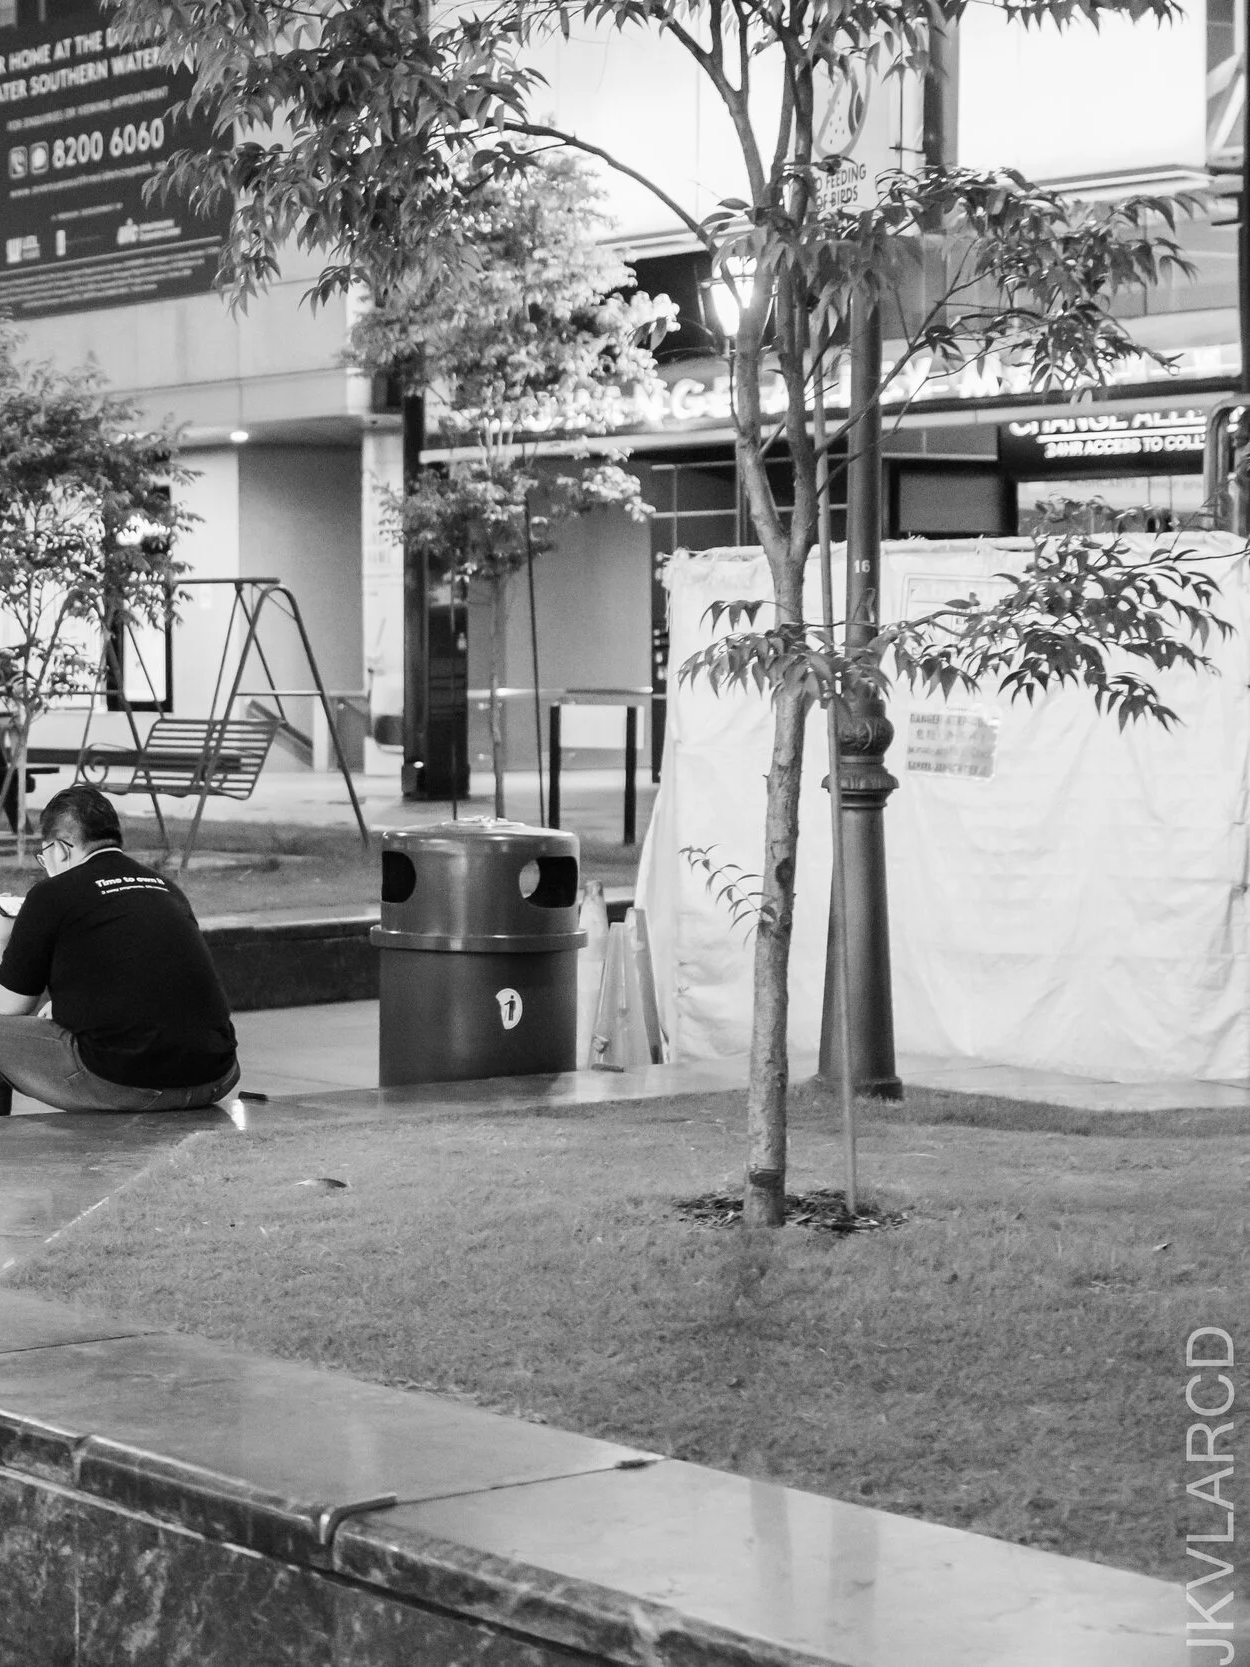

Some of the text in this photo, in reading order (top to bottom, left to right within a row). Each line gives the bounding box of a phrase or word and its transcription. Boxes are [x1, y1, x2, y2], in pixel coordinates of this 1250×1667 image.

[9, 44, 51, 71] HOME
[53, 38, 72, 61] AT
[74, 30, 104, 55] THE
[30, 59, 108, 96] SOUTHERN
[52, 117, 165, 170] 8200 6060
[826, 163, 867, 190] FEEDING
[816, 185, 858, 211] OF BIRDS
[1083, 438, 1141, 456] ACCESS
[1142, 436, 1163, 453] TO
[1163, 434, 1207, 452] COLL
